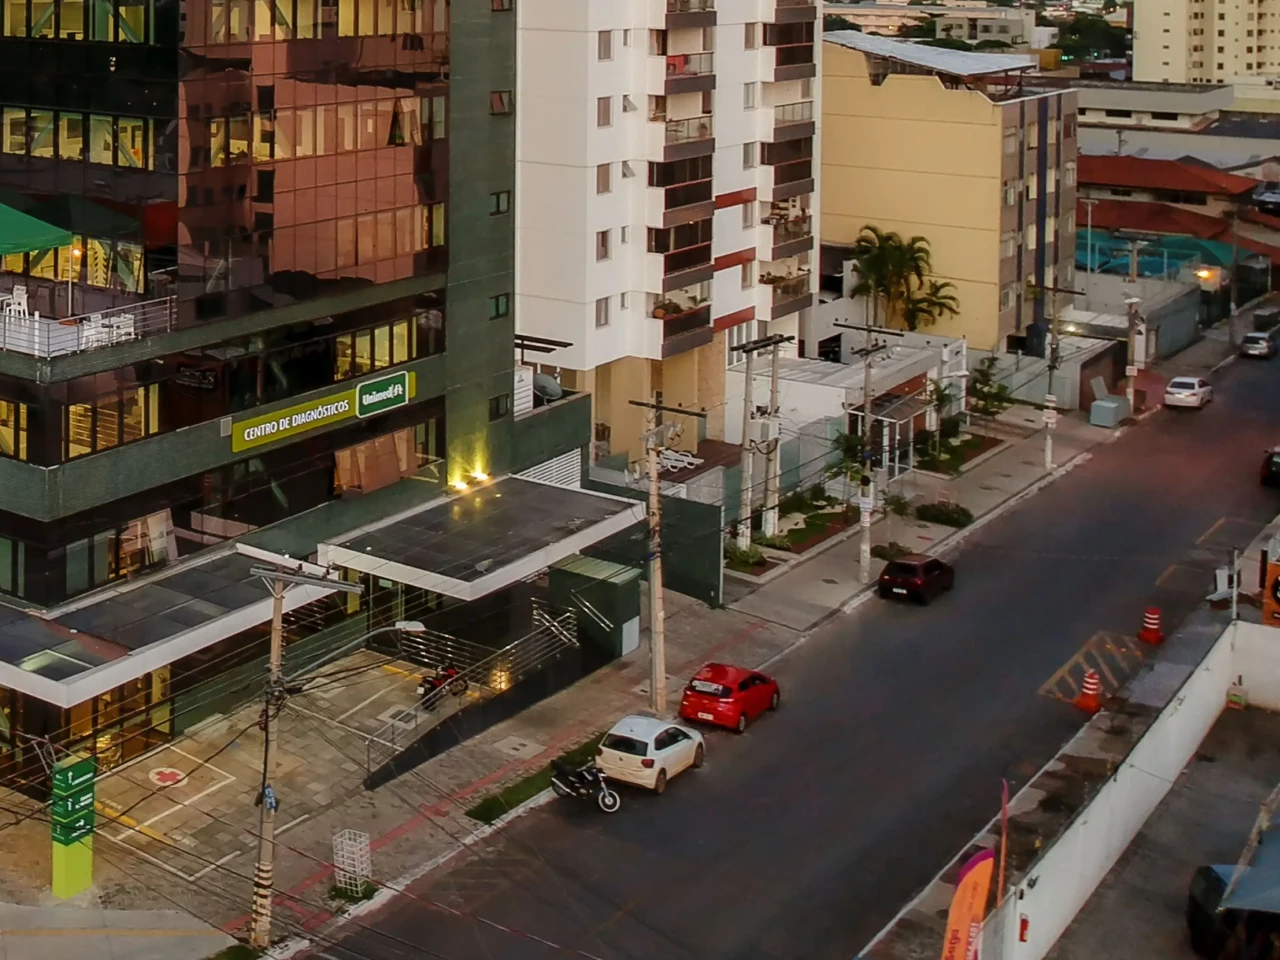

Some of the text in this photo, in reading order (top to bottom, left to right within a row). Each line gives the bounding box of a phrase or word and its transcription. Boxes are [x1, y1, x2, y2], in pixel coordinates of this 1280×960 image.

[362, 386, 392, 406] Unimed
[244, 399, 349, 441] CENTRO DE DIAGNÓSTICOS
